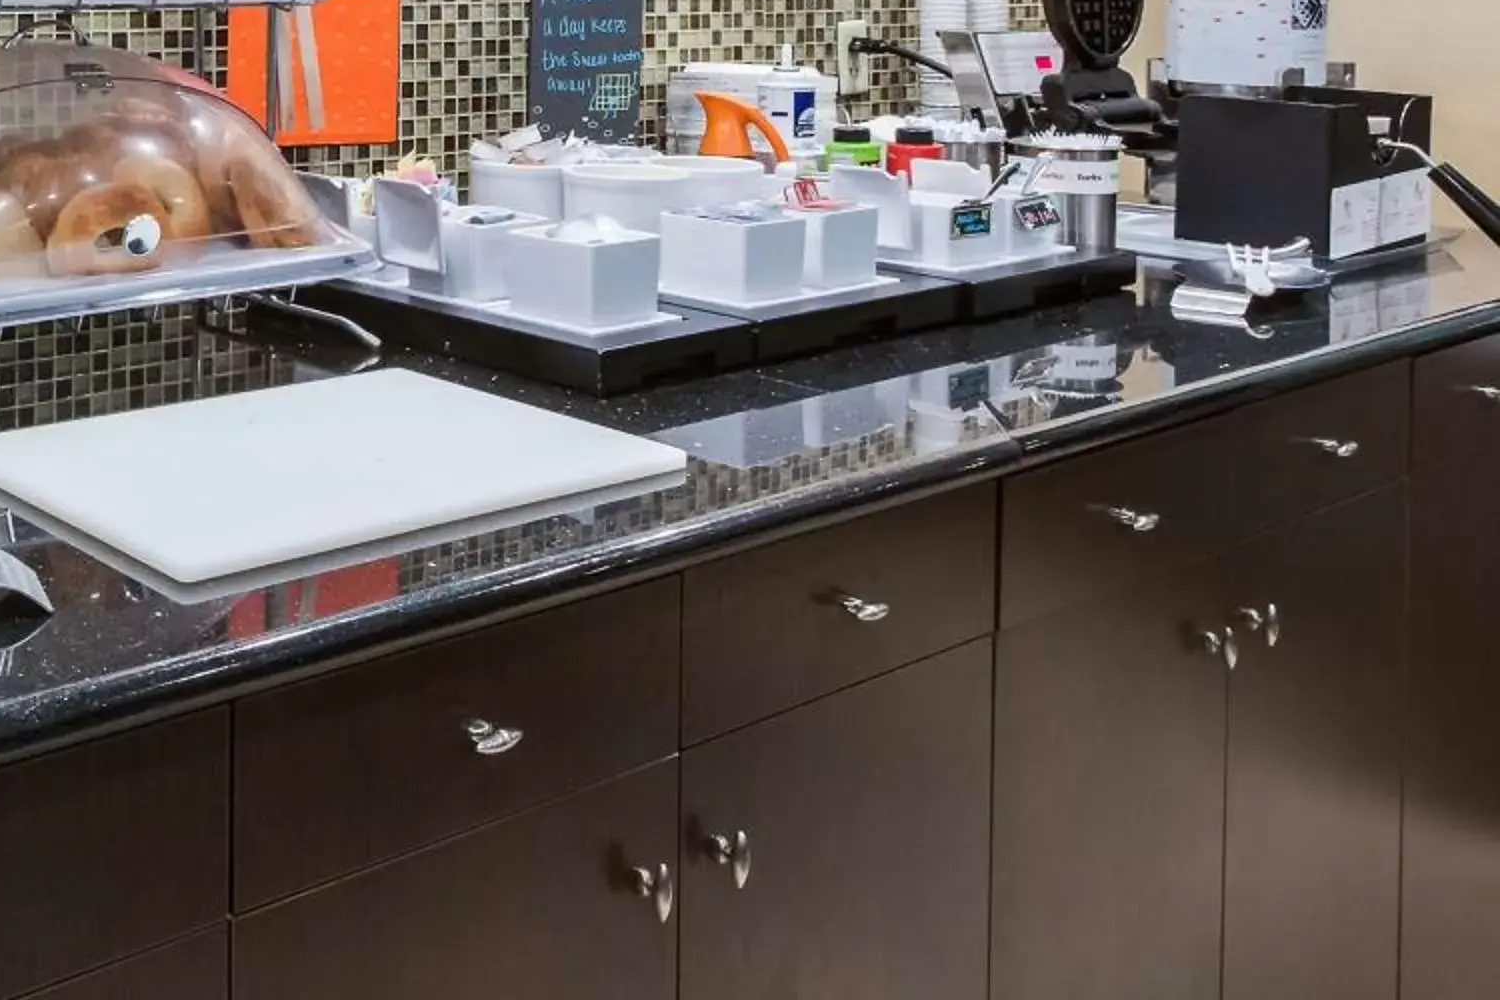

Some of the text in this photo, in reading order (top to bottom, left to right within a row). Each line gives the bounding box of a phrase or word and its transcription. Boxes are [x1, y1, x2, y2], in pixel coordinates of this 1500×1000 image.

[543, 20, 553, 36] a
[559, 17, 586, 40] day
[542, 49, 566, 71] the
